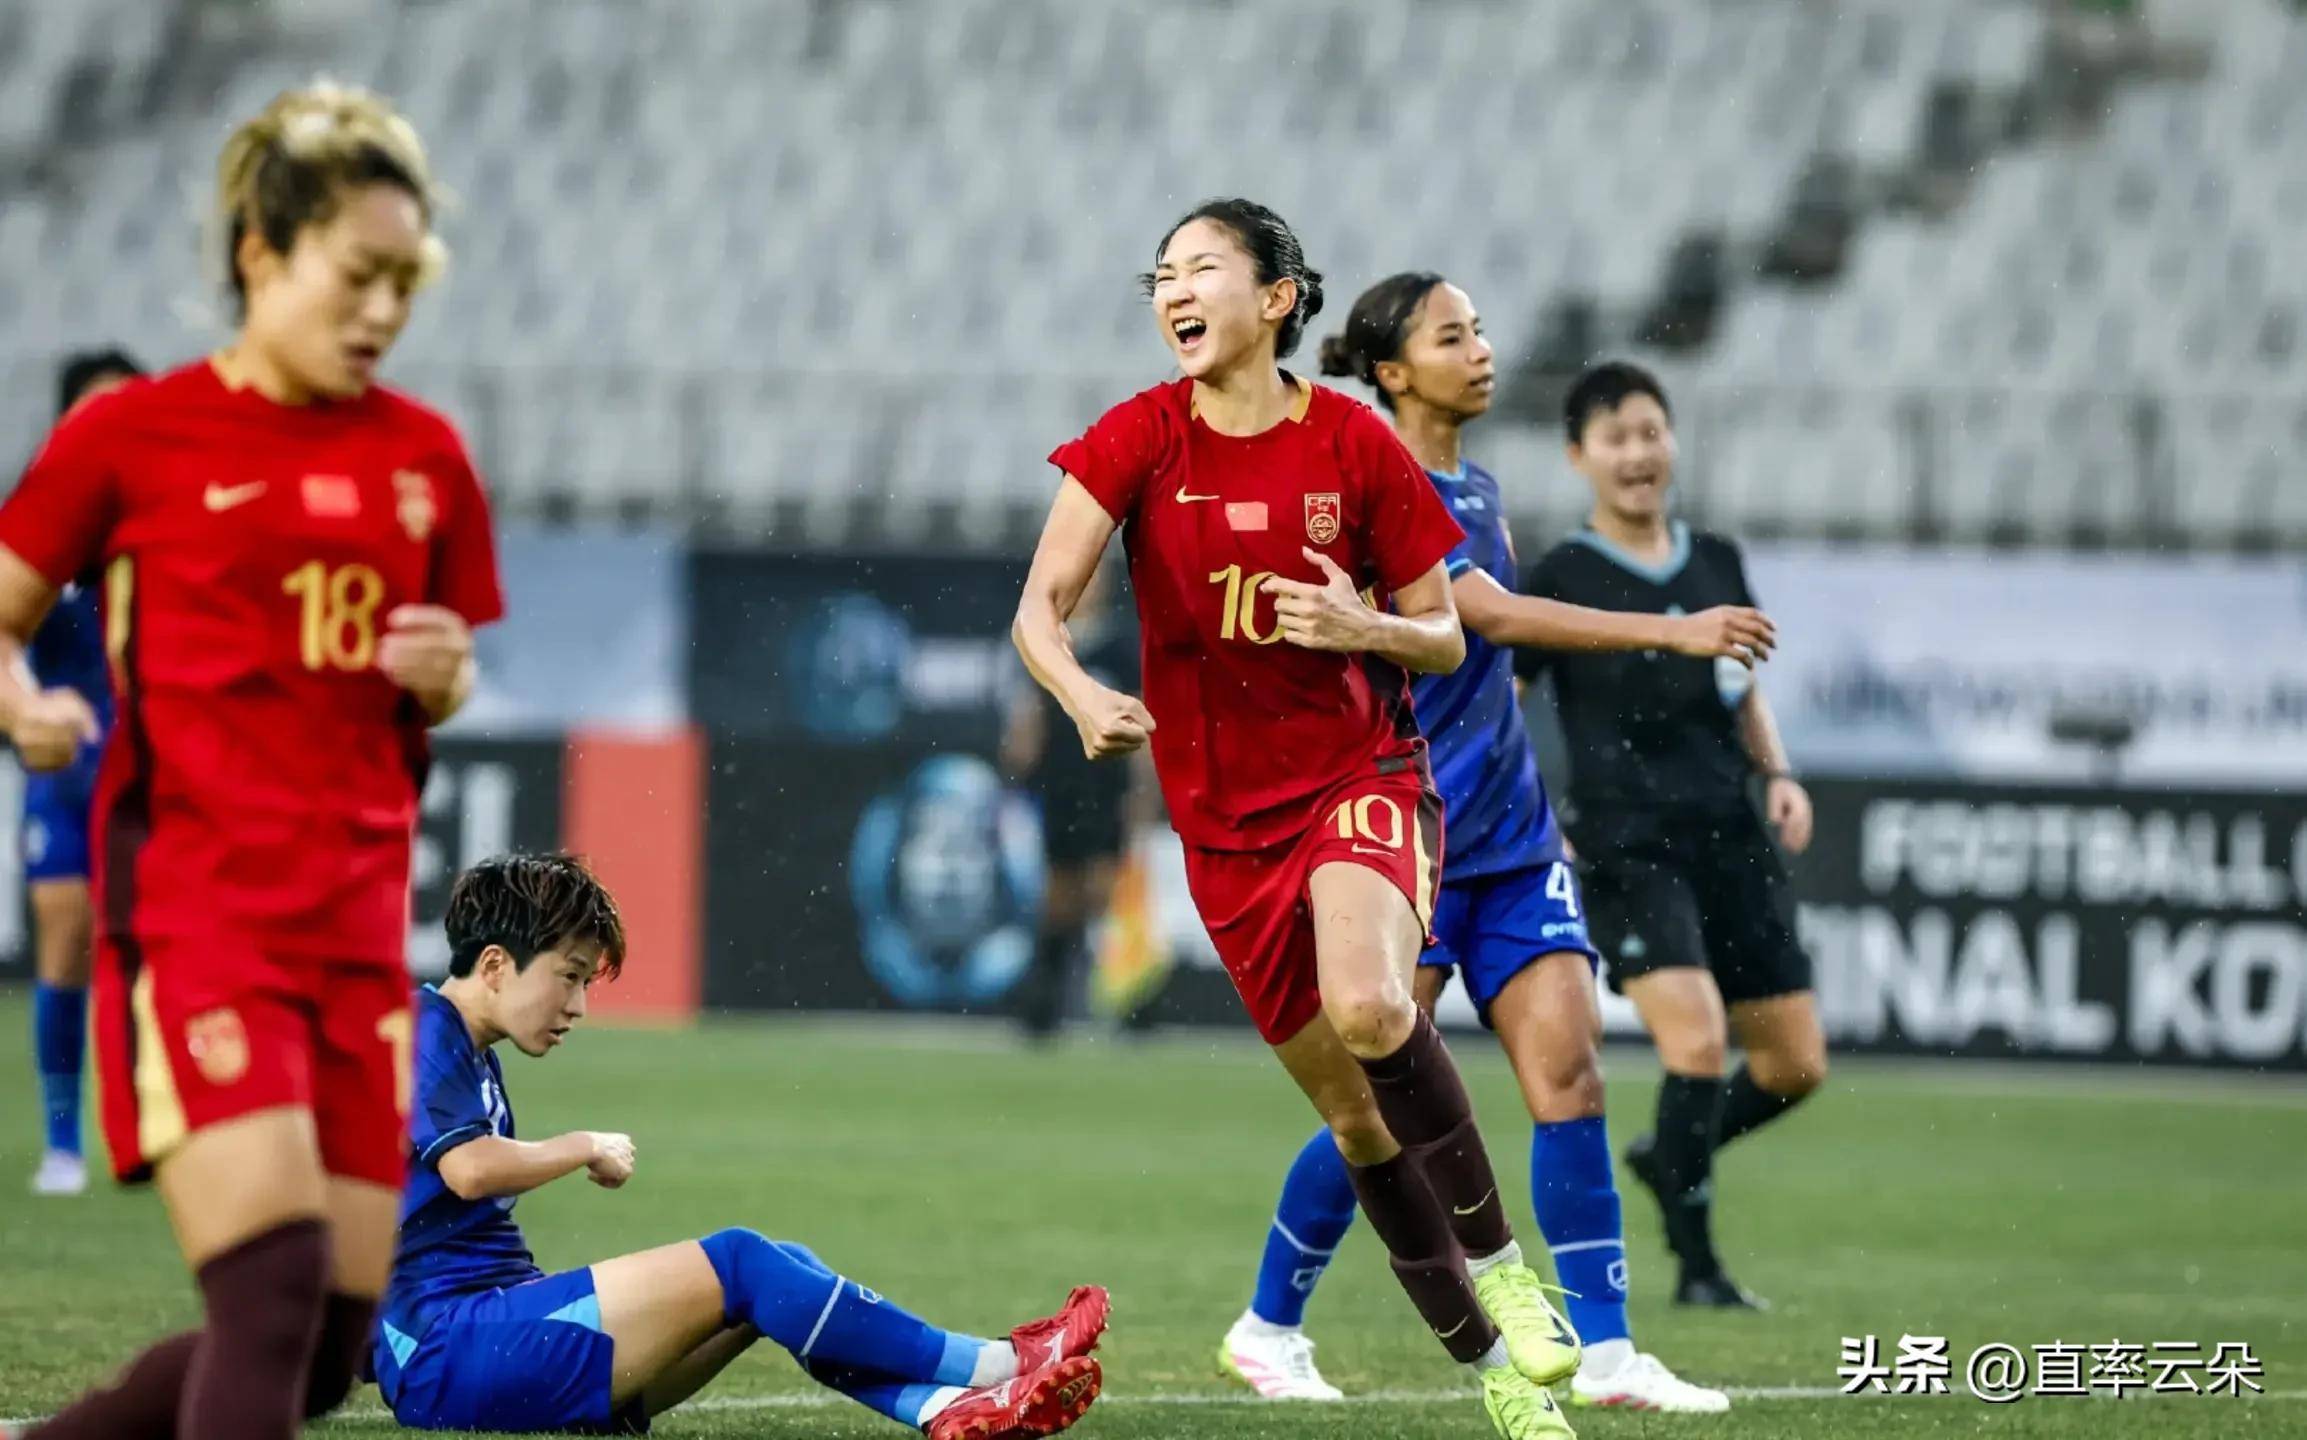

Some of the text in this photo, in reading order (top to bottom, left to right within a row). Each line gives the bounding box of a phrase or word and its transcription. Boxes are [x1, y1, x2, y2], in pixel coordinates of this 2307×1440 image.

[281, 560, 384, 671] 18
[1208, 563, 1285, 645] 10
[1325, 794, 1404, 849] 10
[1860, 799, 2291, 909] FOOTBALL
[1545, 861, 1579, 919] 4
[2127, 914, 2307, 1060] KO
